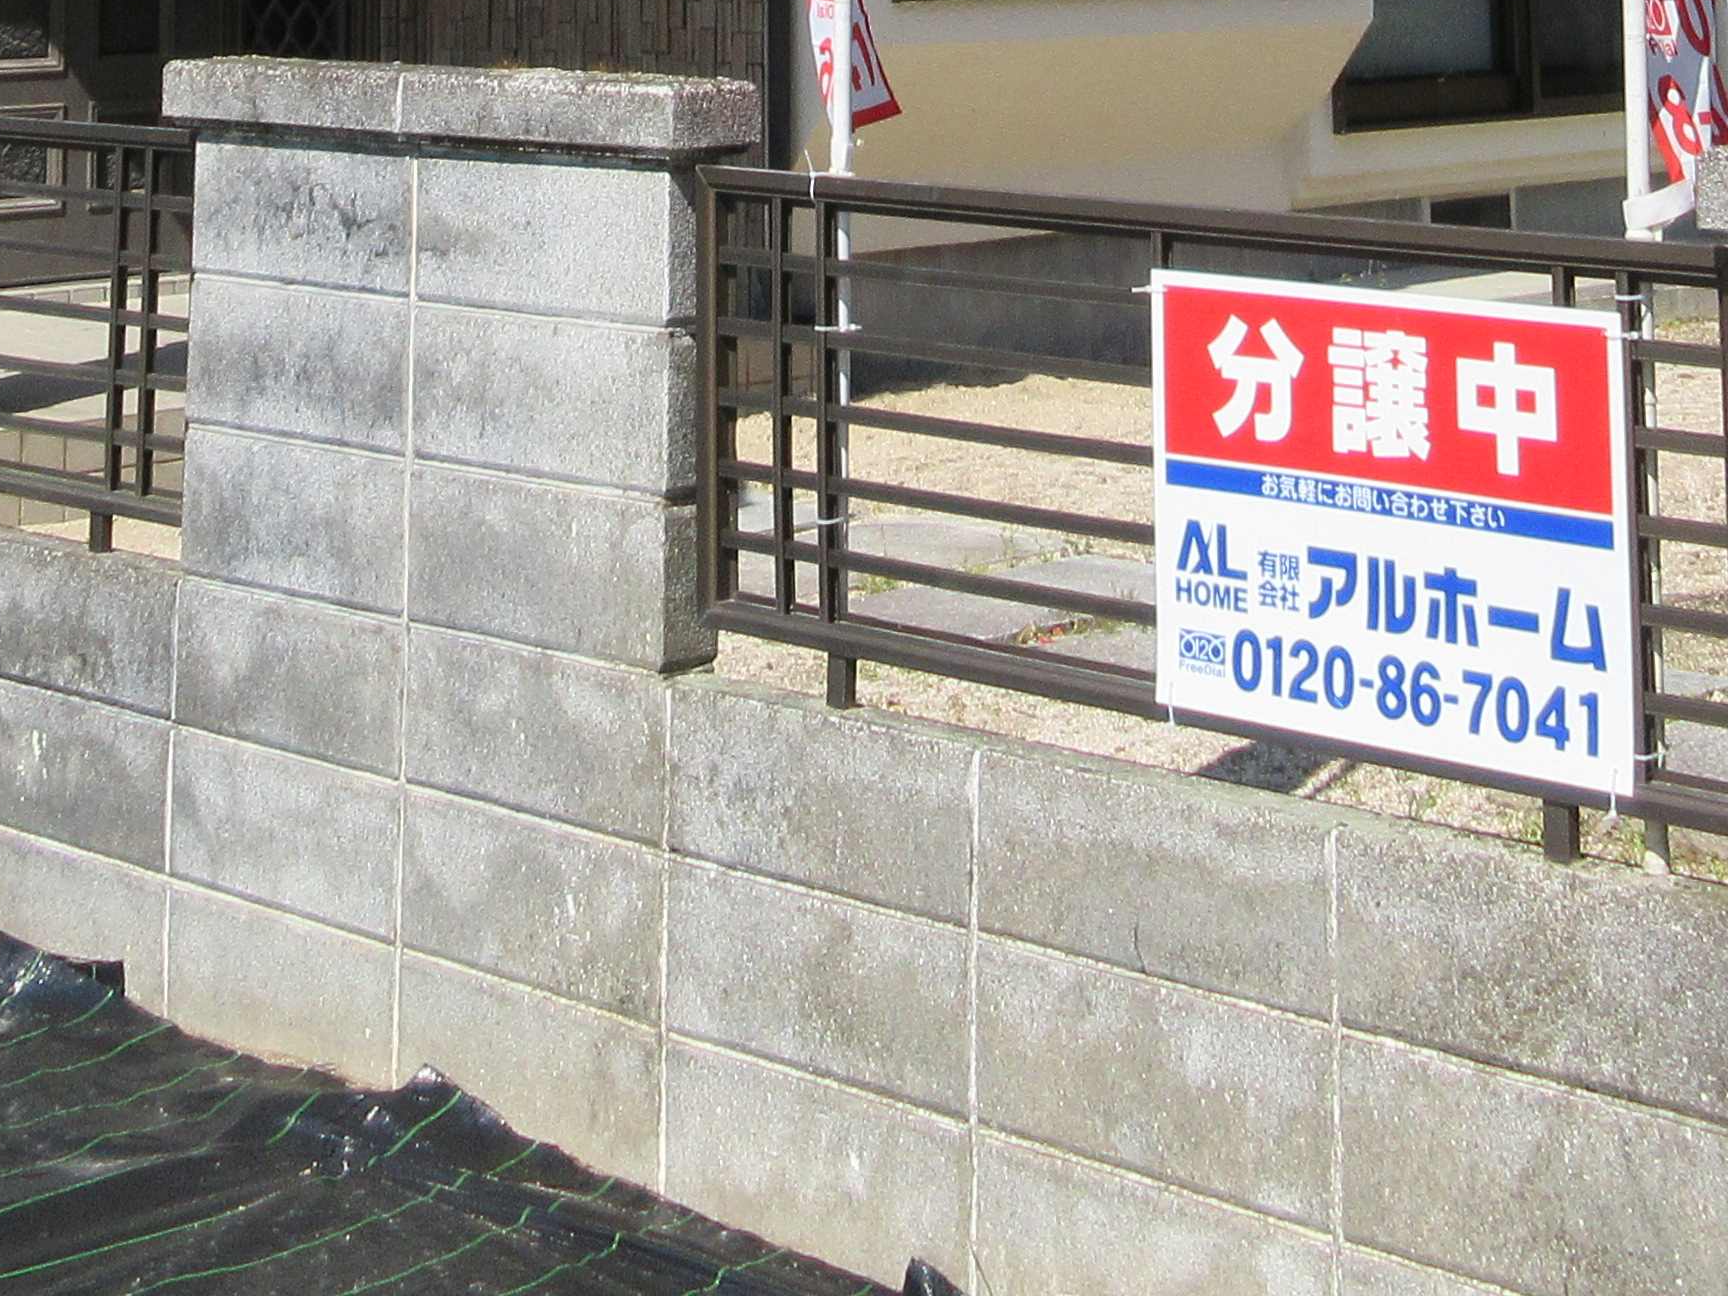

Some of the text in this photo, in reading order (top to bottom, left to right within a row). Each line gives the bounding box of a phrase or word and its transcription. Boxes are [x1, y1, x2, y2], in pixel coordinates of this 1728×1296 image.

[1206, 313, 1559, 477] 分譲中
[1260, 473, 1506, 529] お気軽にお問い合わせ下さい
[1176, 519, 1248, 581] AL
[1258, 548, 1300, 582] 有限
[1175, 576, 1249, 614] HOME
[1258, 580, 1300, 613] 会社
[1306, 545, 1608, 673] アルホーム
[1231, 628, 1601, 759] 0120-86-7041
